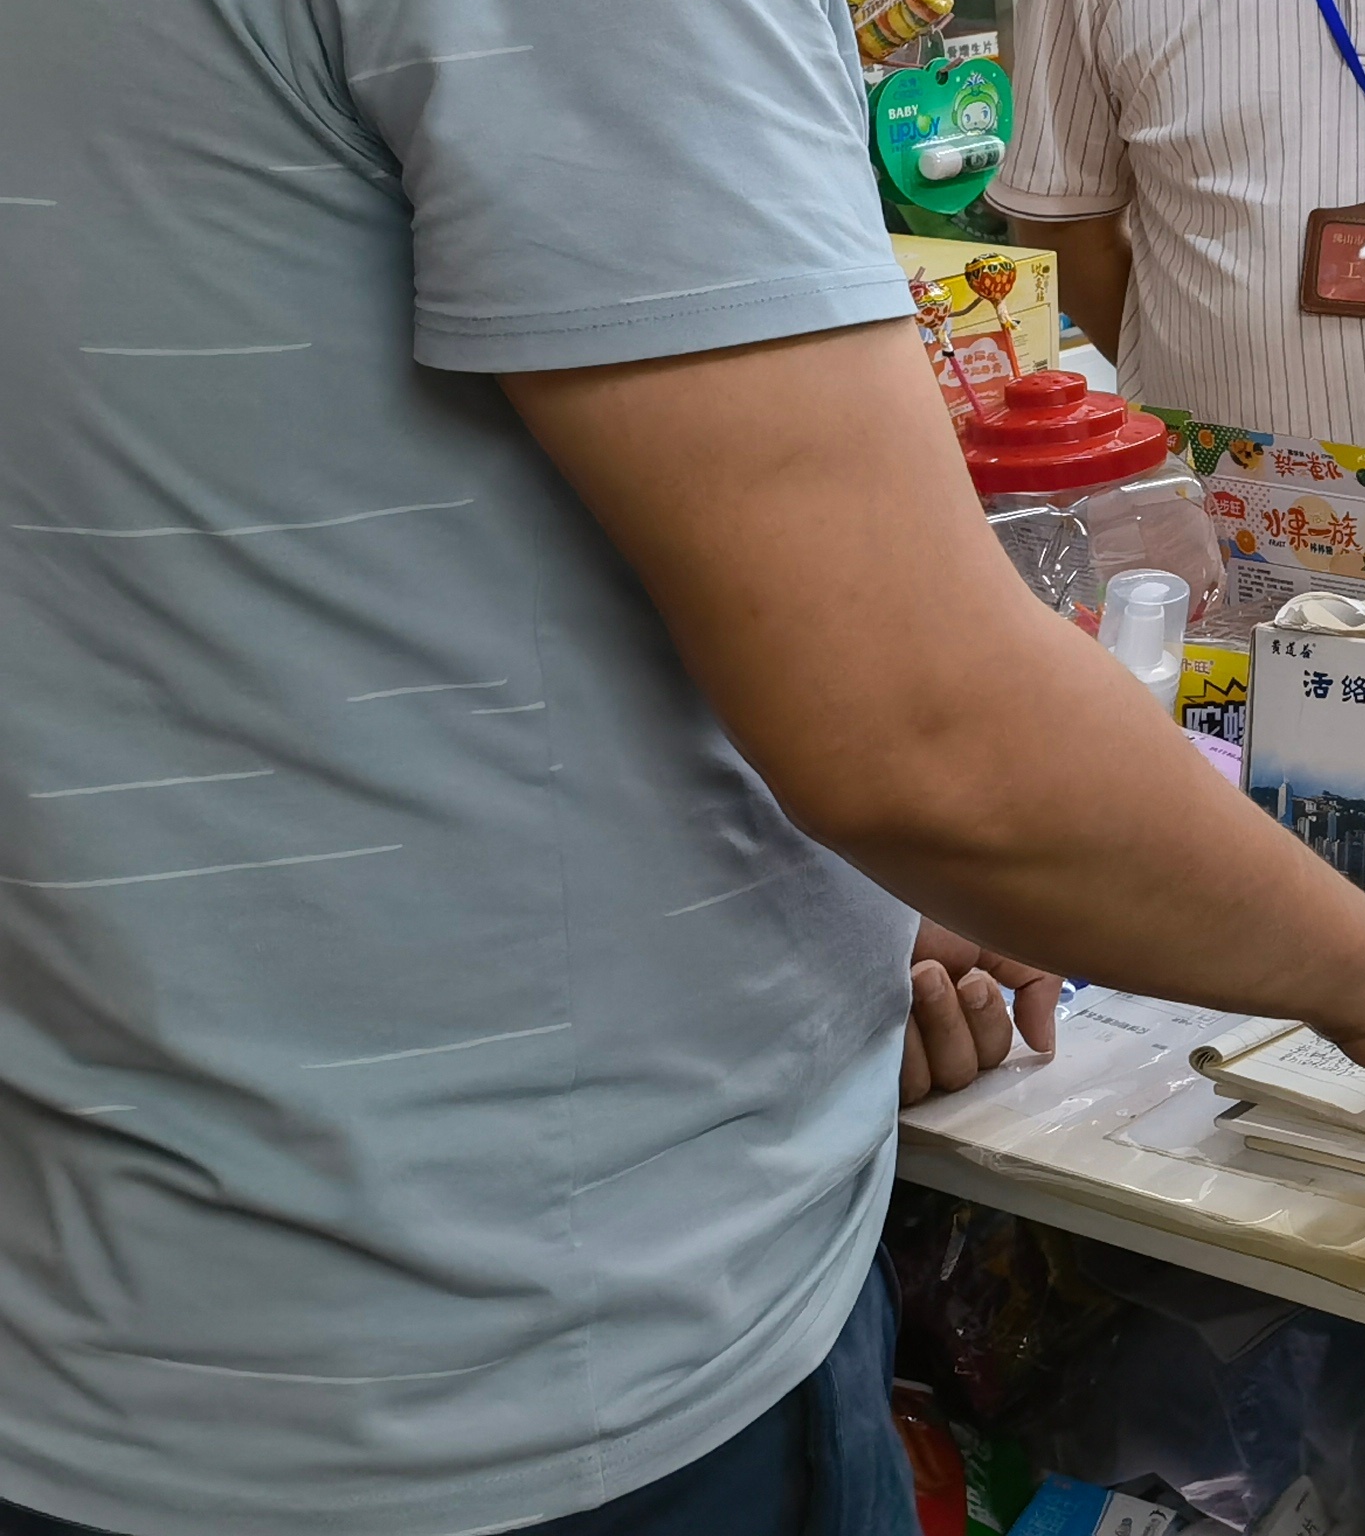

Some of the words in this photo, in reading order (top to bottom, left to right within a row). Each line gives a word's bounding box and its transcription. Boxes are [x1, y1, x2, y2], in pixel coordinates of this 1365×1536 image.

[888, 104, 919, 120] BABY
[1263, 506, 1363, 555] 水果一族
